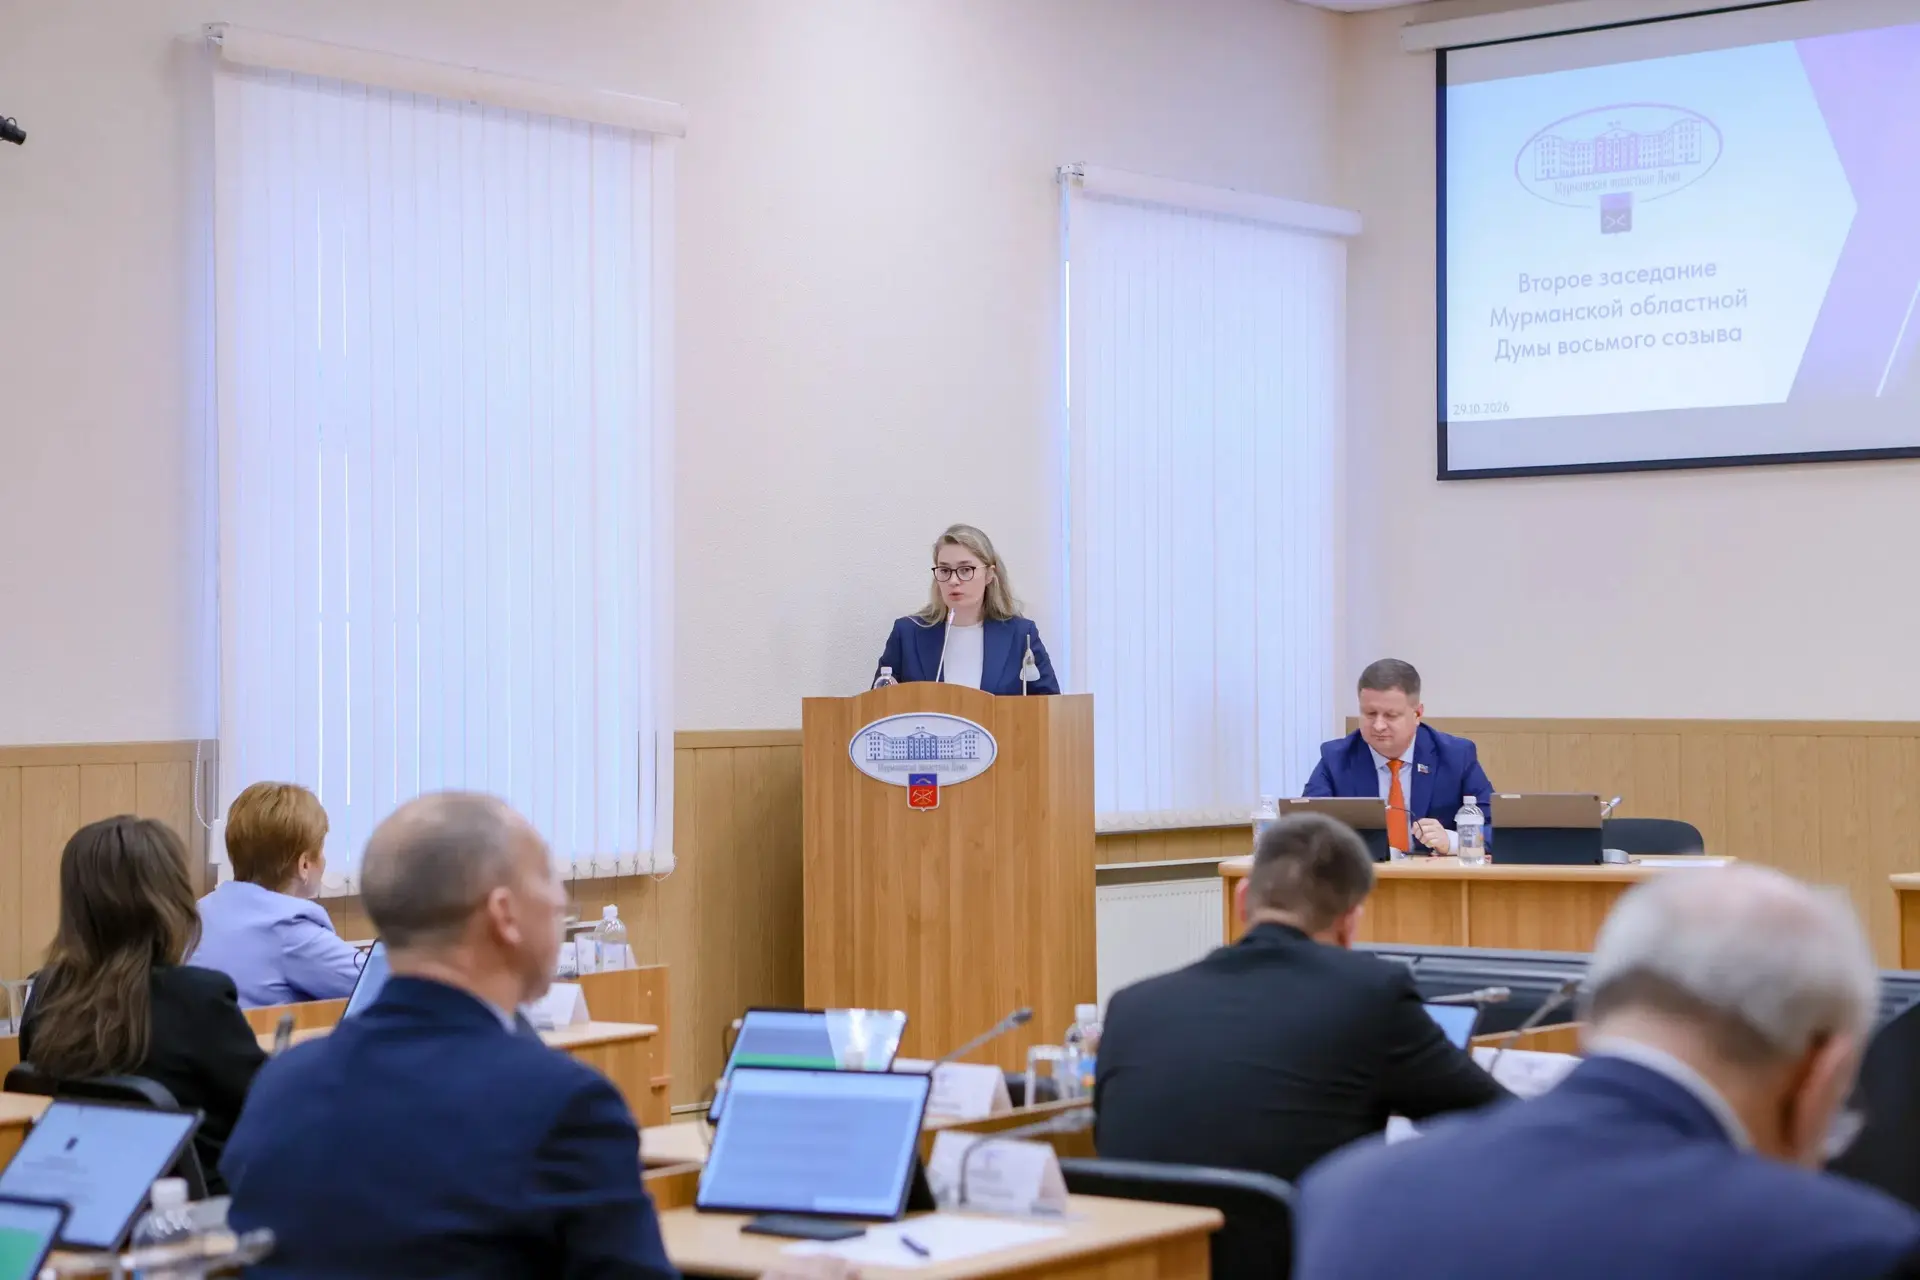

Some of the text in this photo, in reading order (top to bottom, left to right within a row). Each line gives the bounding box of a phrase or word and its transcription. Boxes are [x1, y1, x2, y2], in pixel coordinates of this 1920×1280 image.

[1517, 261, 1718, 296] Второе заседание
[1489, 287, 1748, 332] Мурманской областной
[1494, 326, 1743, 364] Думы восьмого созыва
[1452, 401, 1510, 416] 29.10.2026
